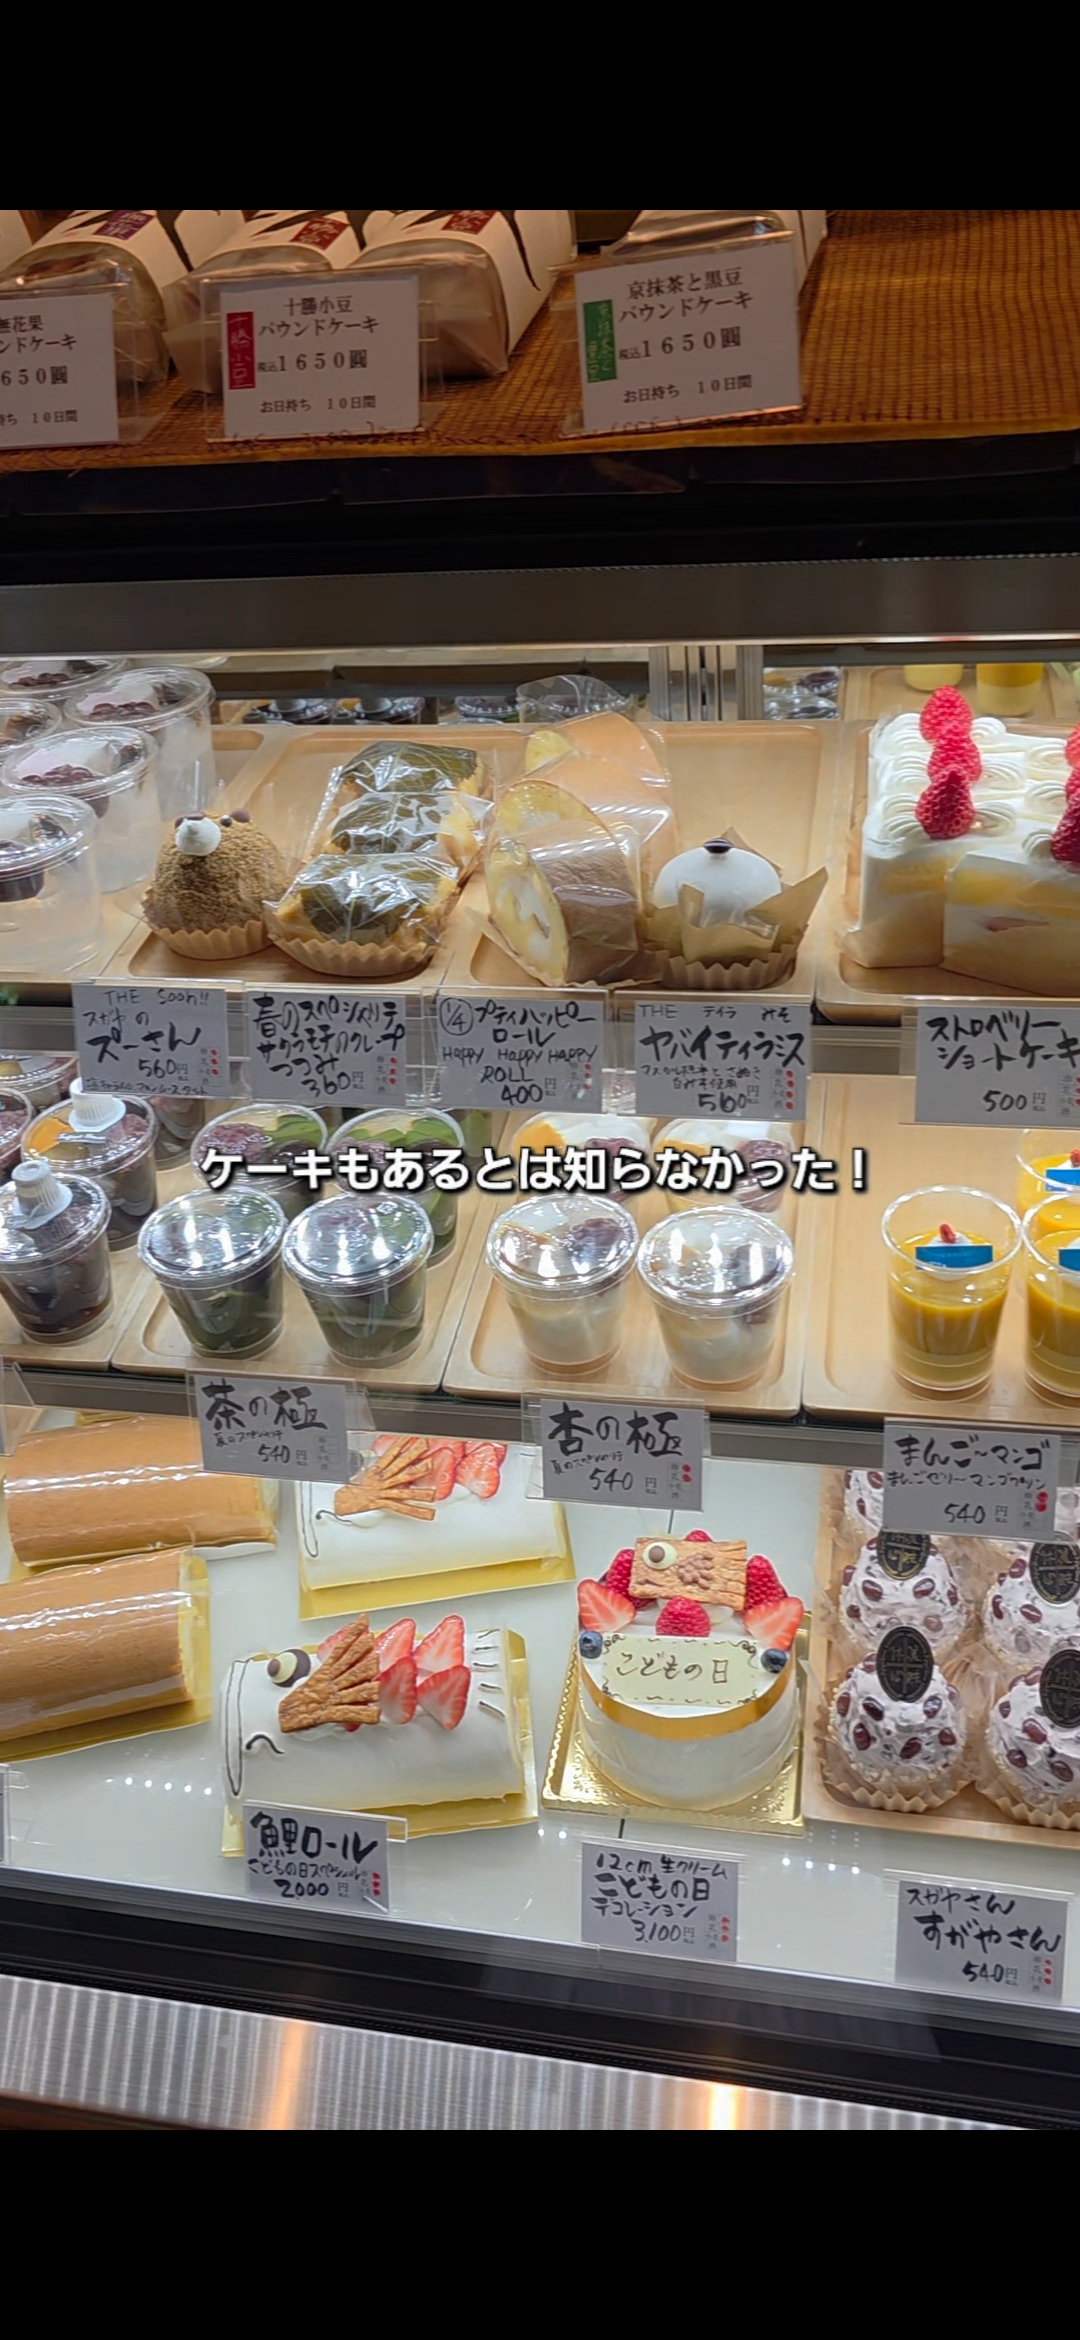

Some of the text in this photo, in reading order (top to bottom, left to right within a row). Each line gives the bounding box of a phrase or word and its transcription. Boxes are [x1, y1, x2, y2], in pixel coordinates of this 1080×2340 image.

[628, 267, 743, 300] 京抹茶と黒豆
[284, 296, 353, 316] 十勝小豆
[619, 291, 753, 323] パウンドケーキ
[259, 316, 380, 338] パウンドケーキ
[623, 374, 752, 403] お日持ち 10日間
[32, 410, 78, 424] 10日間
[260, 395, 376, 413] お日持ち 10日間
[104, 989, 140, 1006] THE
[638, 1004, 678, 1019] THE
[761, 1007, 791, 1023] みそ
[926, 1009, 1062, 1043] ストロベリー
[493, 1026, 556, 1047] ロール
[639, 1025, 806, 1068] ヤバイティラミス
[937, 1028, 1080, 1072] ショートケーキ
[269, 1052, 339, 1077] つつみ
[480, 1065, 534, 1084] ROLL
[202, 1378, 328, 1430] 茶の極
[548, 1402, 683, 1457] 杏の極
[617, 1651, 728, 1683] こどもの日
[250, 1811, 378, 1864] 鯉ロール
[596, 1853, 728, 1879] 12cm 生クリーム
[594, 1872, 710, 1901] こどもの日
[906, 1887, 1015, 1915] スガヤさん
[913, 1910, 1062, 1954] すがやさん
